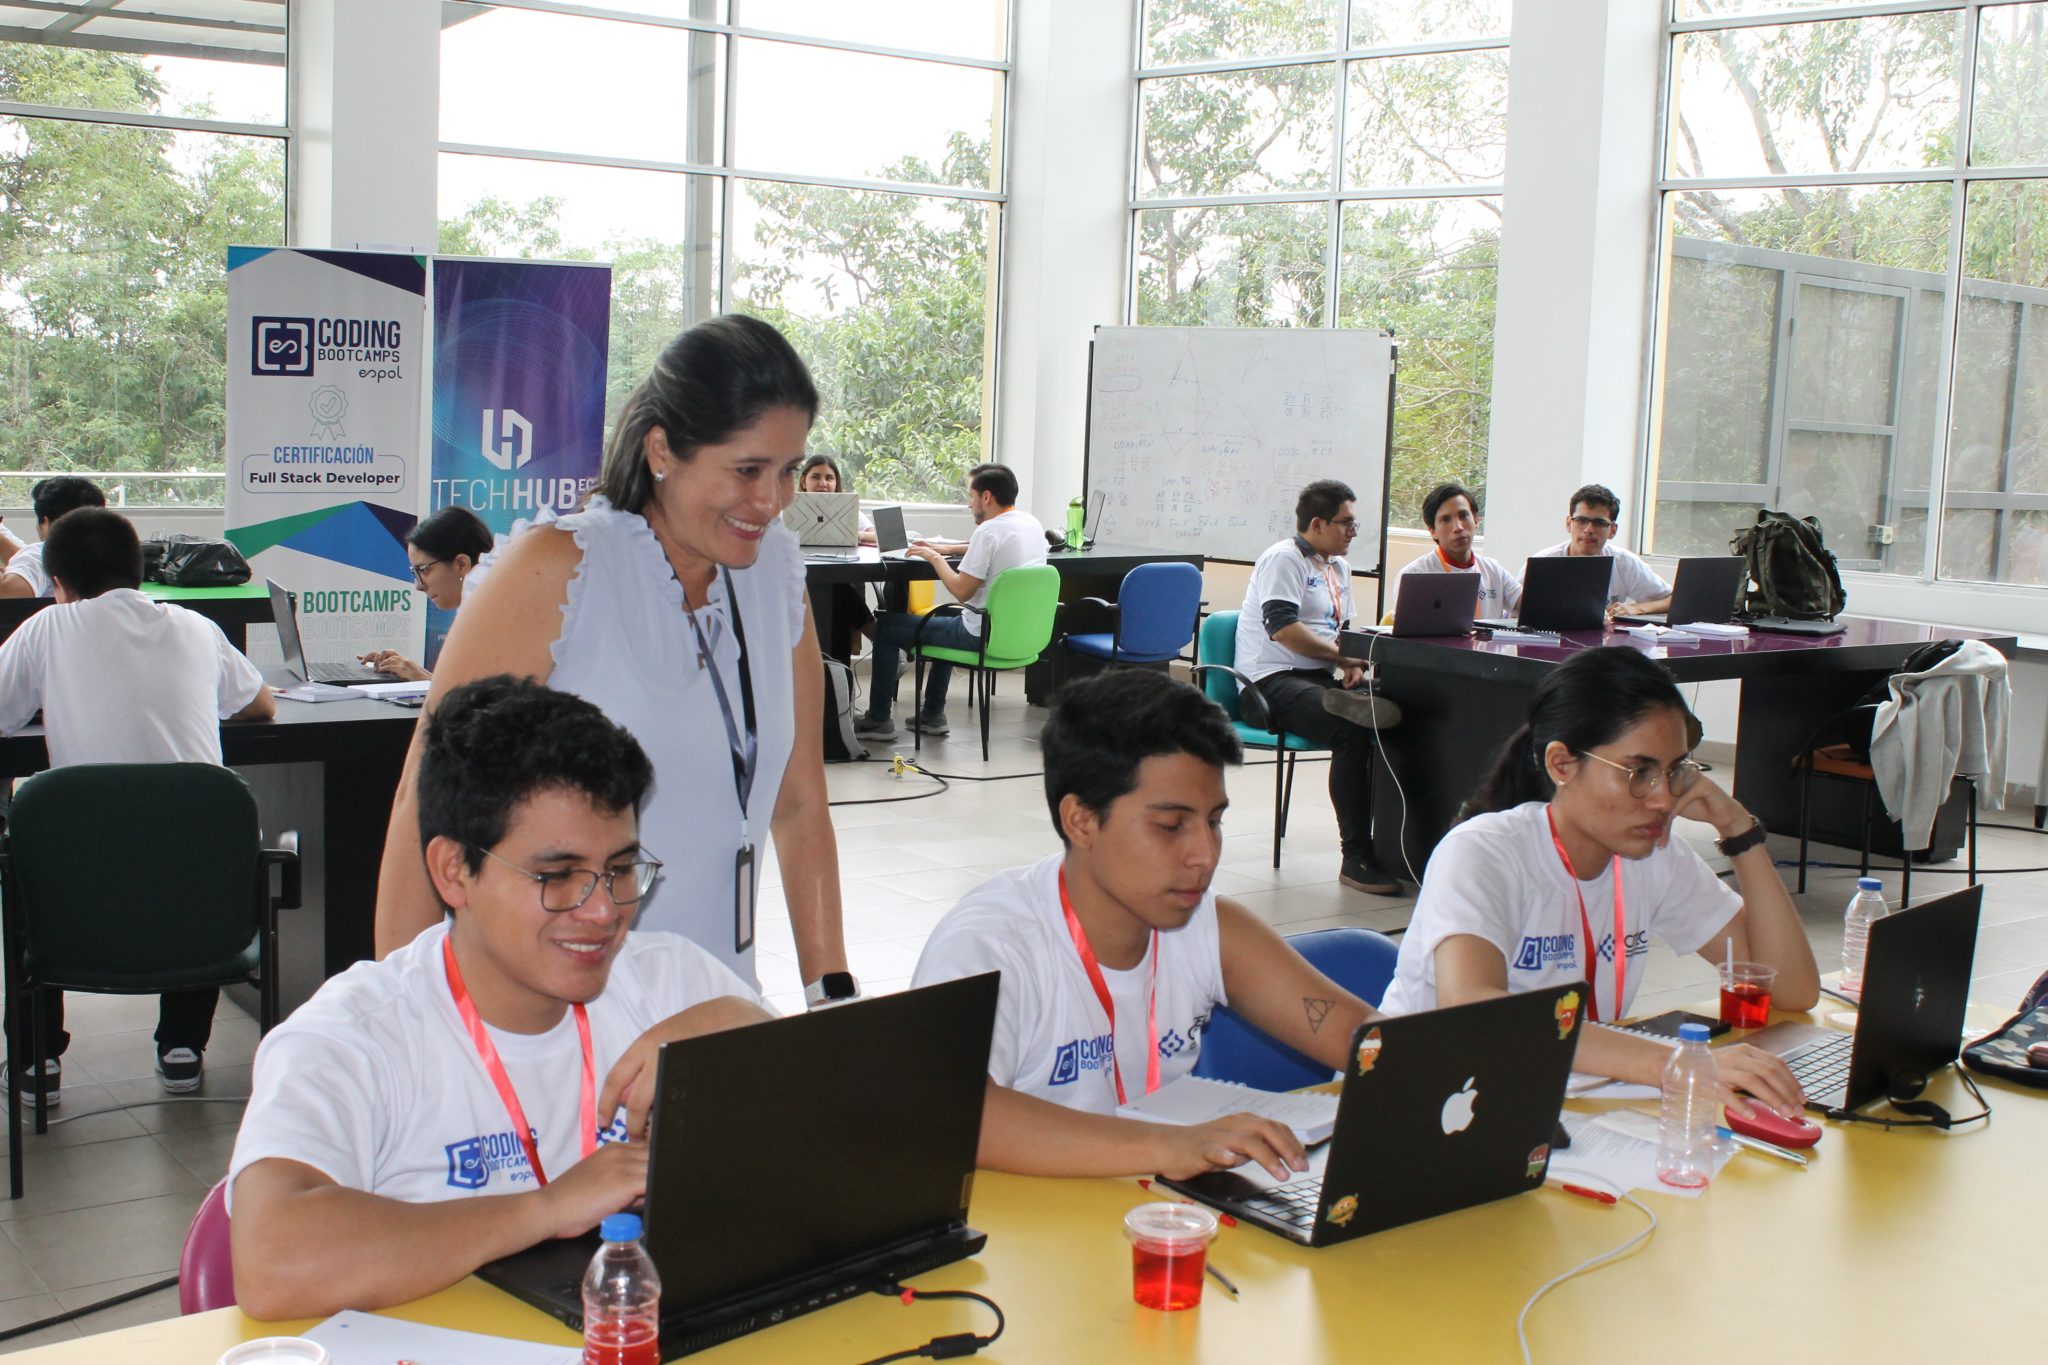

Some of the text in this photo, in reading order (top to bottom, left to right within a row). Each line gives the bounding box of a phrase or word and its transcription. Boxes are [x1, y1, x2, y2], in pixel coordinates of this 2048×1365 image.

[318, 318, 401, 349] CODING
[318, 348, 400, 363] BOOTCAMPS
[358, 365, 403, 383] espol
[273, 444, 374, 464] CERTIFICACIÓN
[250, 472, 401, 485] Full Stack Developer
[303, 589, 412, 614] BOOTCAMPS
